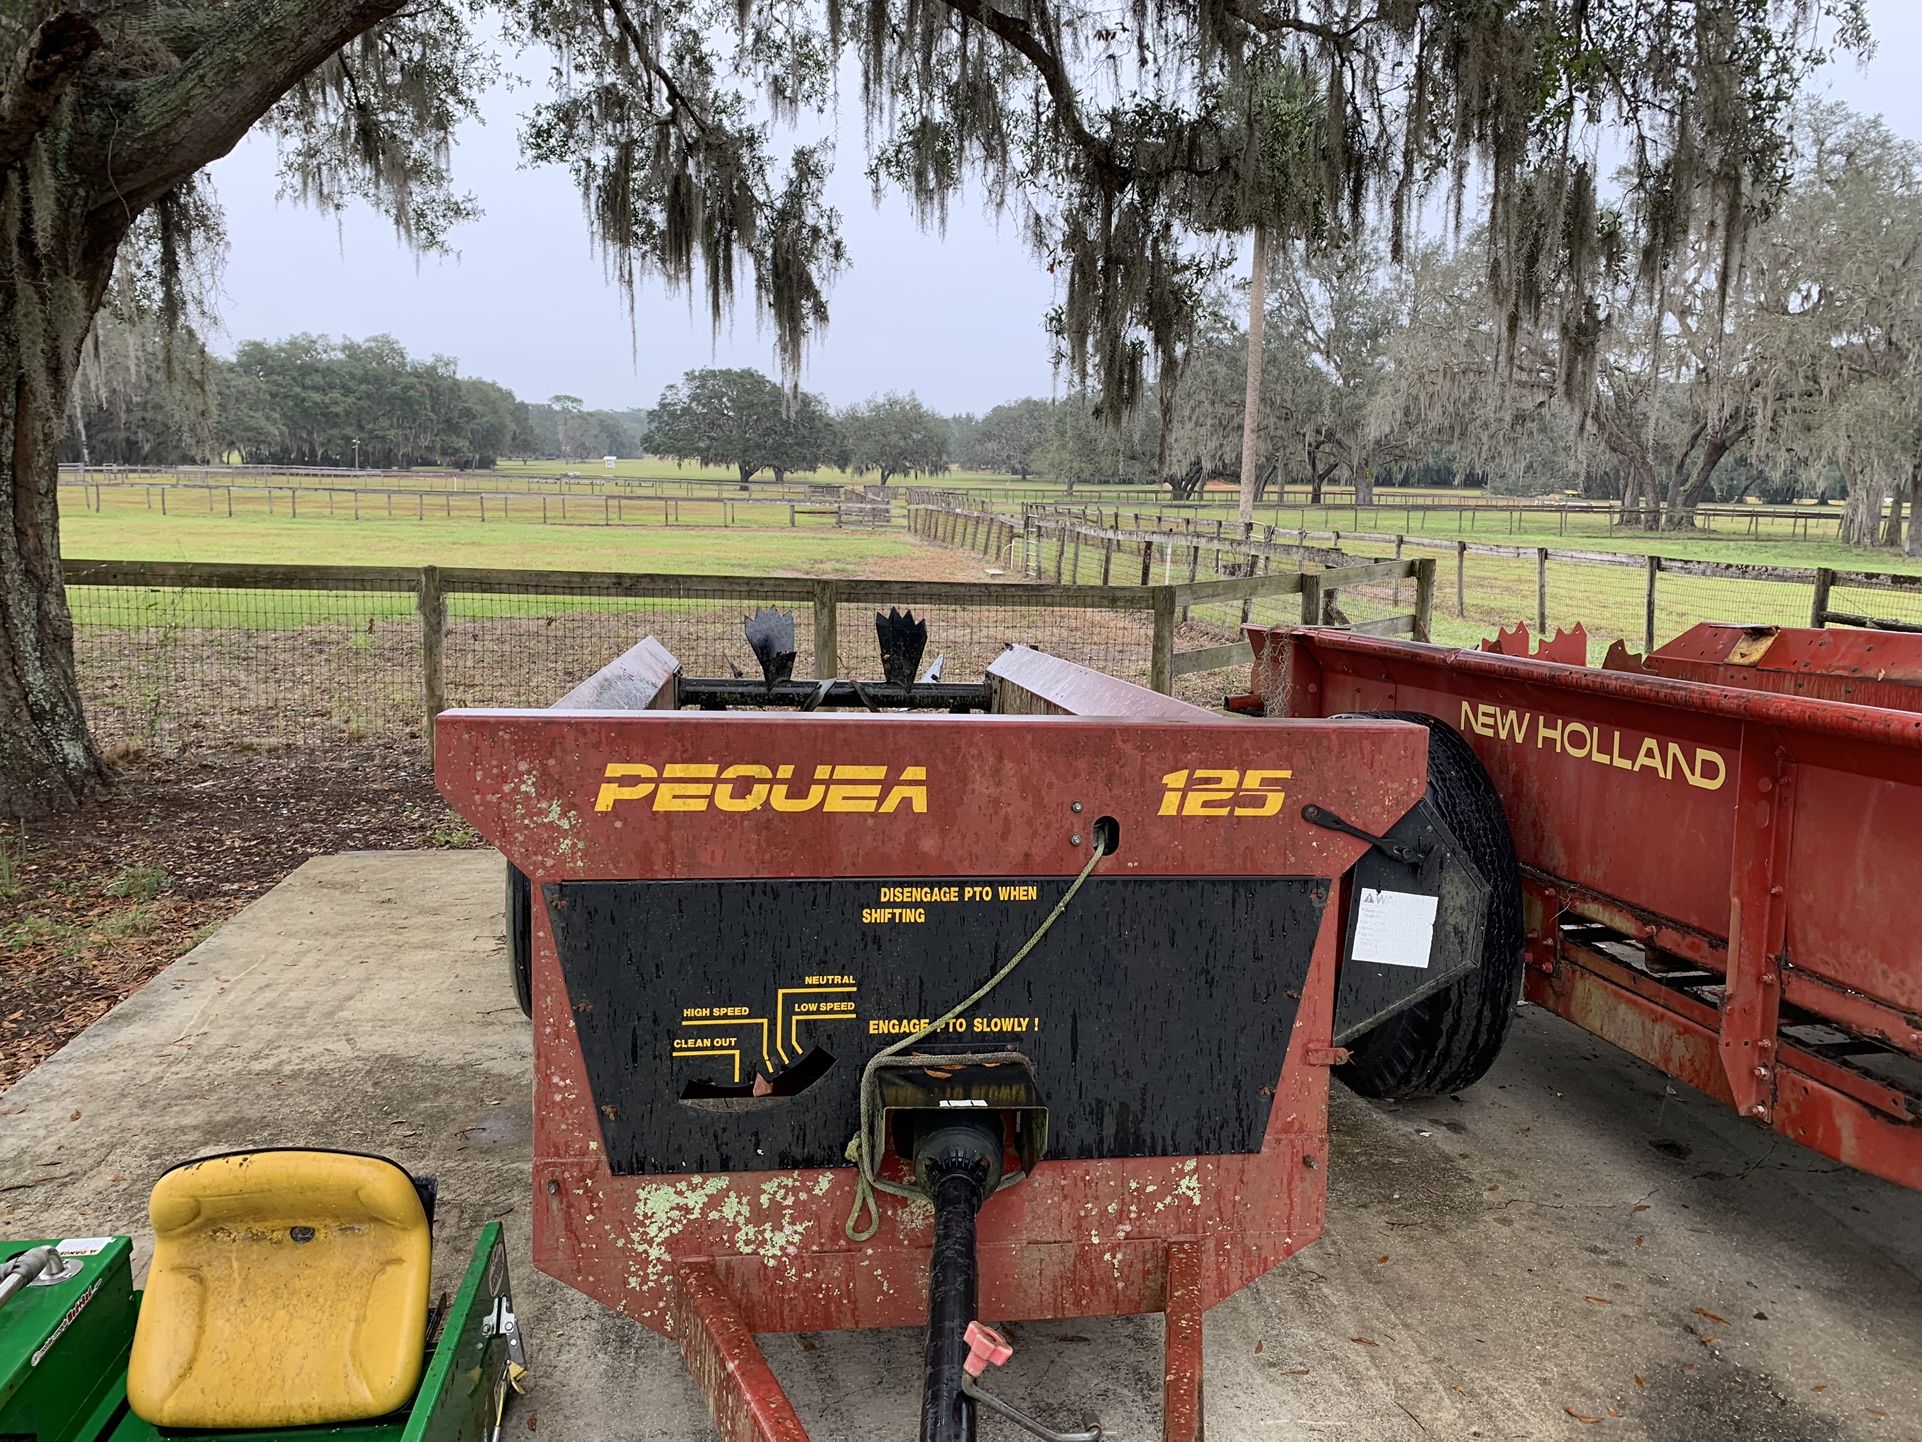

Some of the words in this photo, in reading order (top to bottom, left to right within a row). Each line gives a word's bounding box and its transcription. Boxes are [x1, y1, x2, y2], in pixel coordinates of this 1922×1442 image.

[1460, 700, 1531, 744] NEW
[1537, 715, 1727, 791] HOLLAND
[593, 762, 928, 814] PEQUEA
[1157, 768, 1293, 818] 125
[880, 886, 959, 903] DISENGAGE
[964, 886, 993, 901] PTO
[998, 885, 1038, 901] WHEN
[862, 908, 926, 924] SHIFTING
[804, 975, 856, 985] NEUTRAL
[683, 1007, 709, 1017] HIGH
[712, 1006, 750, 1016] SPEED
[794, 1002, 819, 1012] LOW
[819, 1002, 856, 1011] SPEED
[869, 1018, 930, 1035] ENGAGE
[973, 1017, 1030, 1032] SLOWLY
[673, 1038, 711, 1048] CLEAN
[713, 1037, 737, 1047] OUT
